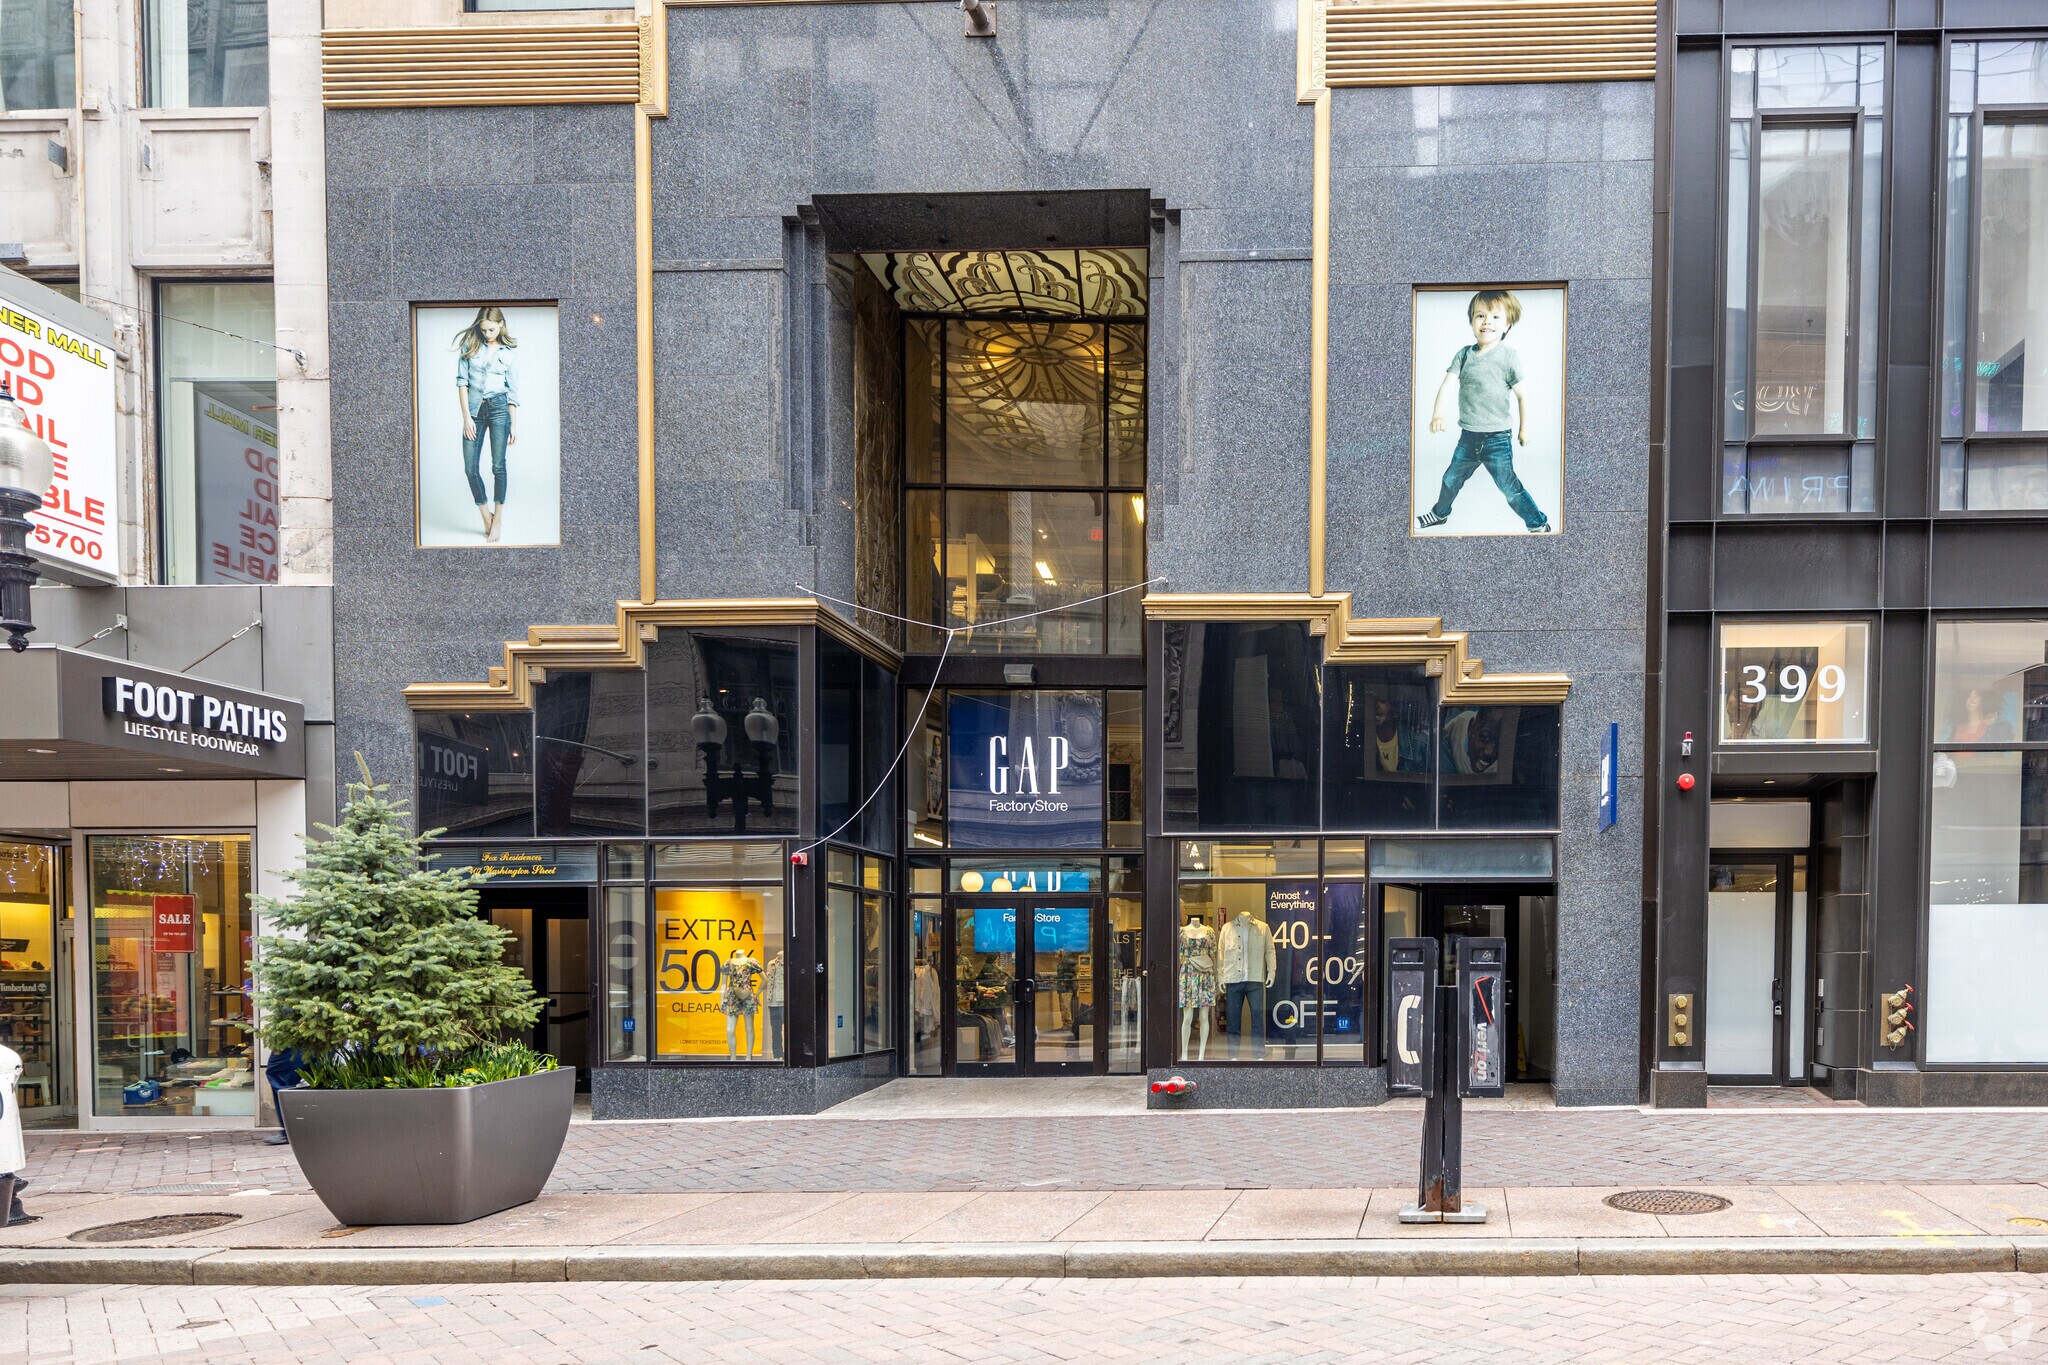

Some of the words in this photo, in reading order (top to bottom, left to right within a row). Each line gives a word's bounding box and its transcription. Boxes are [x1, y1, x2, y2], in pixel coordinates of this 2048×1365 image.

[48, 327, 108, 369] MALL
[1742, 665, 1846, 703] 399
[115, 676, 195, 725] FOOT
[203, 694, 288, 743] PATHS
[124, 721, 188, 744] LIFESTYLE
[191, 734, 260, 757] FOOTWEAR
[989, 735, 1069, 795] GAP
[989, 799, 1069, 814] FactoryStore
[481, 852, 498, 861] Fox
[500, 852, 543, 861] Residences
[483, 865, 530, 878] Washington
[532, 864, 557, 875] Street
[1270, 892, 1301, 900] Almost
[1270, 900, 1315, 911] Everything
[158, 913, 191, 925] SALE
[665, 918, 757, 941] EXTRA
[1306, 956, 1365, 985] 60%
[0, 983, 37, 992] Timberland
[671, 1002, 720, 1013] CLEARA
[1272, 1000, 1338, 1029] OFF
[624, 1020, 634, 1028] GAP
[1338, 1019, 1350, 1027] GAP
[1474, 1022, 1490, 1081] verizon
